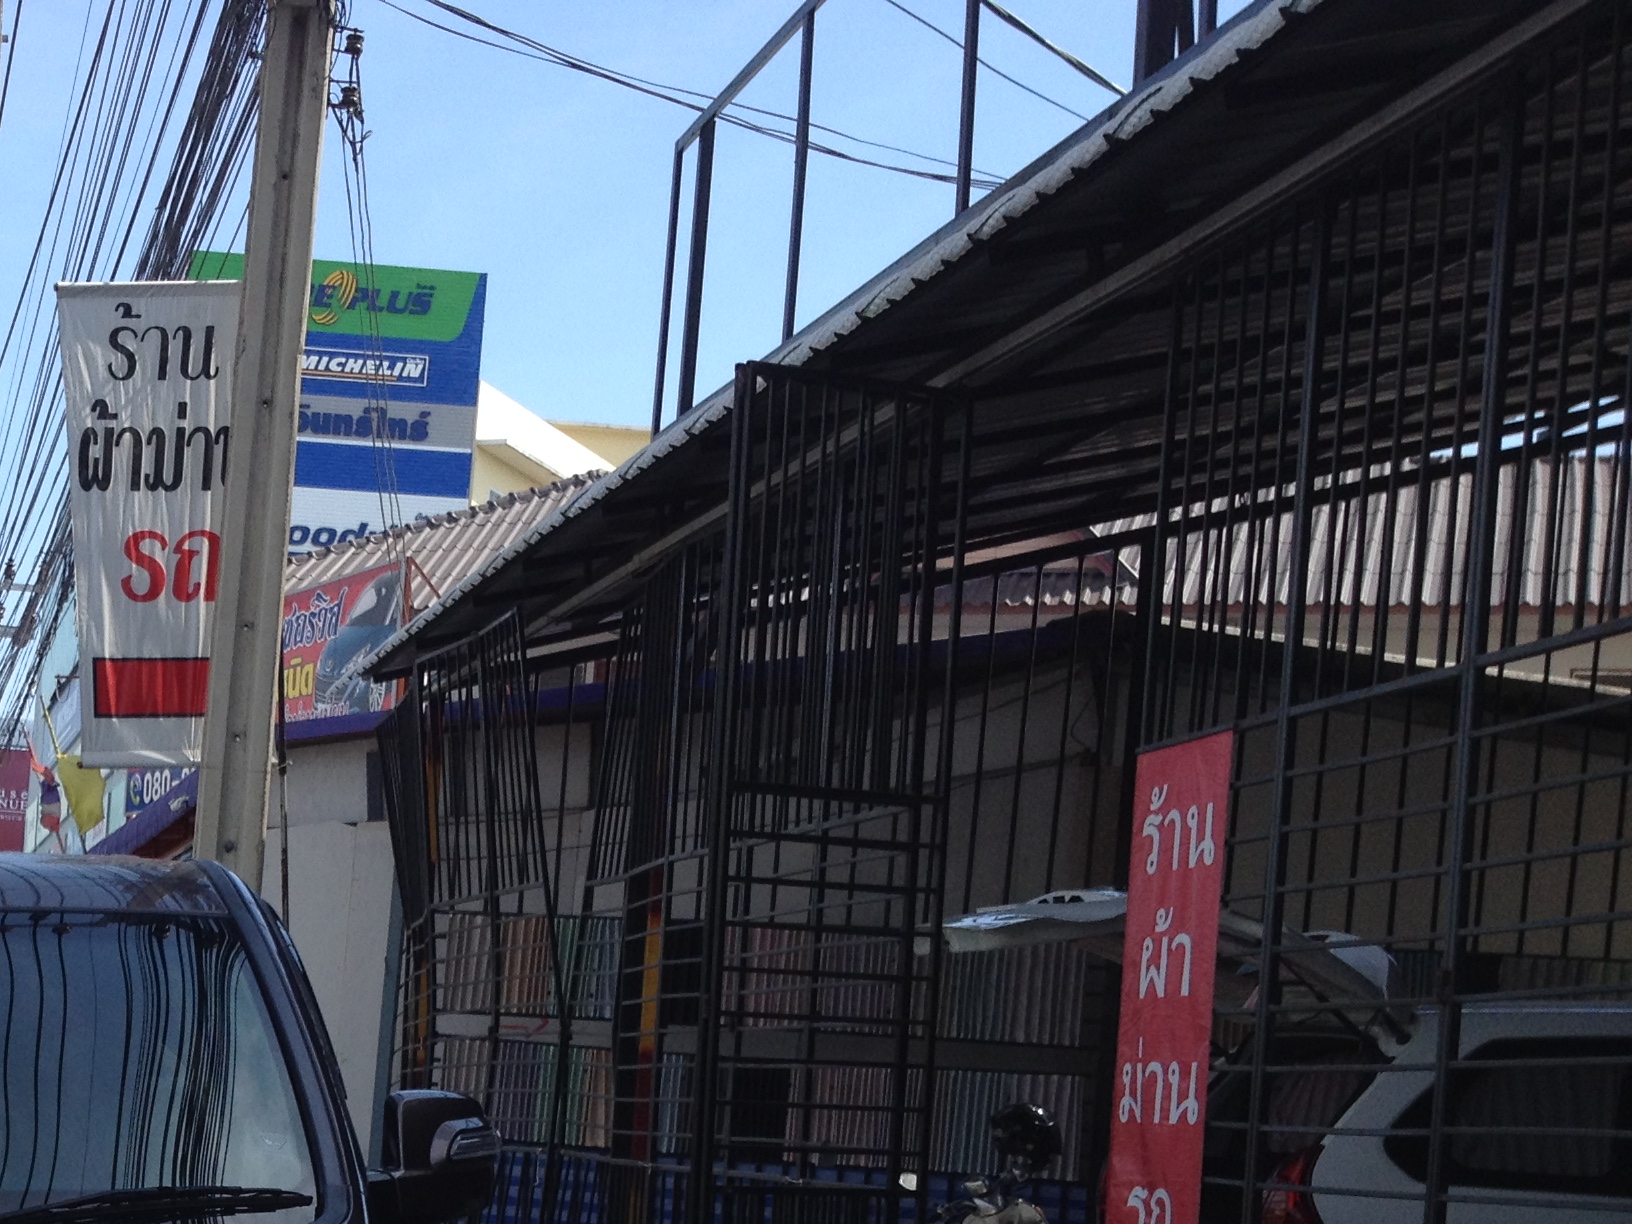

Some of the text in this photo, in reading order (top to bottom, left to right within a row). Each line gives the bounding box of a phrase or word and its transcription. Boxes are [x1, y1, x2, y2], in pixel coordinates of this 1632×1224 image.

[107, 302, 219, 381] ร้าน
[301, 355, 424, 377] MICHELIN
[121, 529, 220, 602] รถ
[1142, 783, 1214, 874] ร้าน
[1139, 906, 1192, 999] ผ้า
[1119, 1036, 1199, 1126] ม่าน
